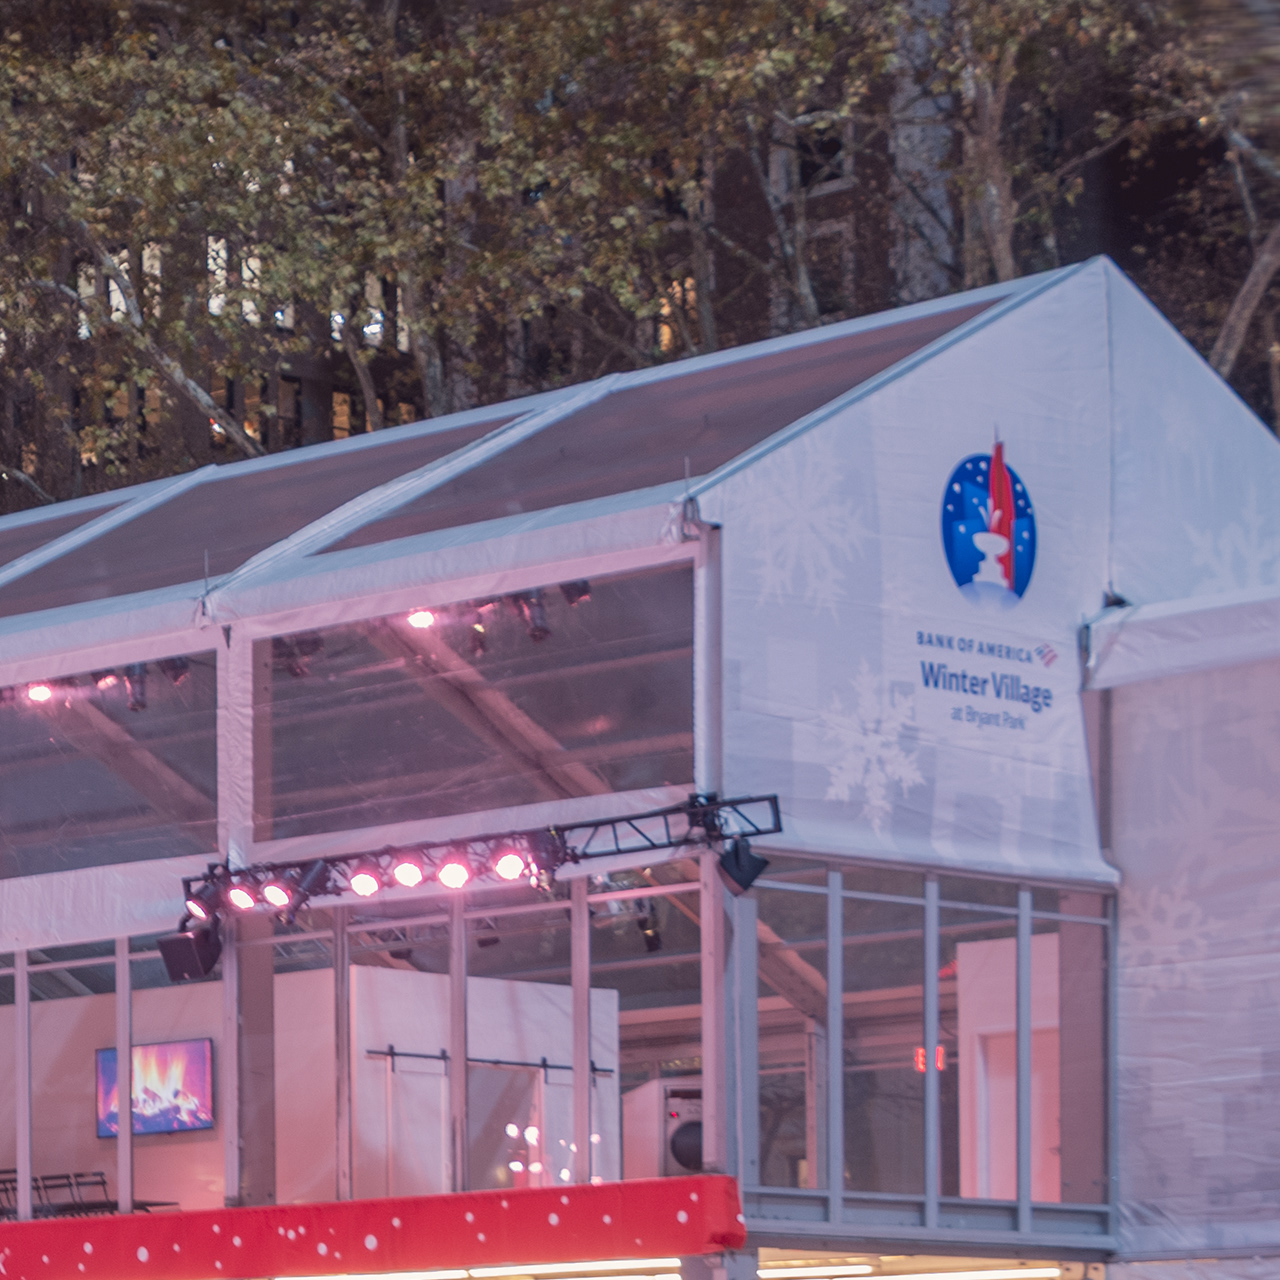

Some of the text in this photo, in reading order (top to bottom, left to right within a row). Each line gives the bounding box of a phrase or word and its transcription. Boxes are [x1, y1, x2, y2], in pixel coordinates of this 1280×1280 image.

[917, 631, 1033, 664] BANK OF AMERICA
[920, 660, 1053, 714] Winter Village
